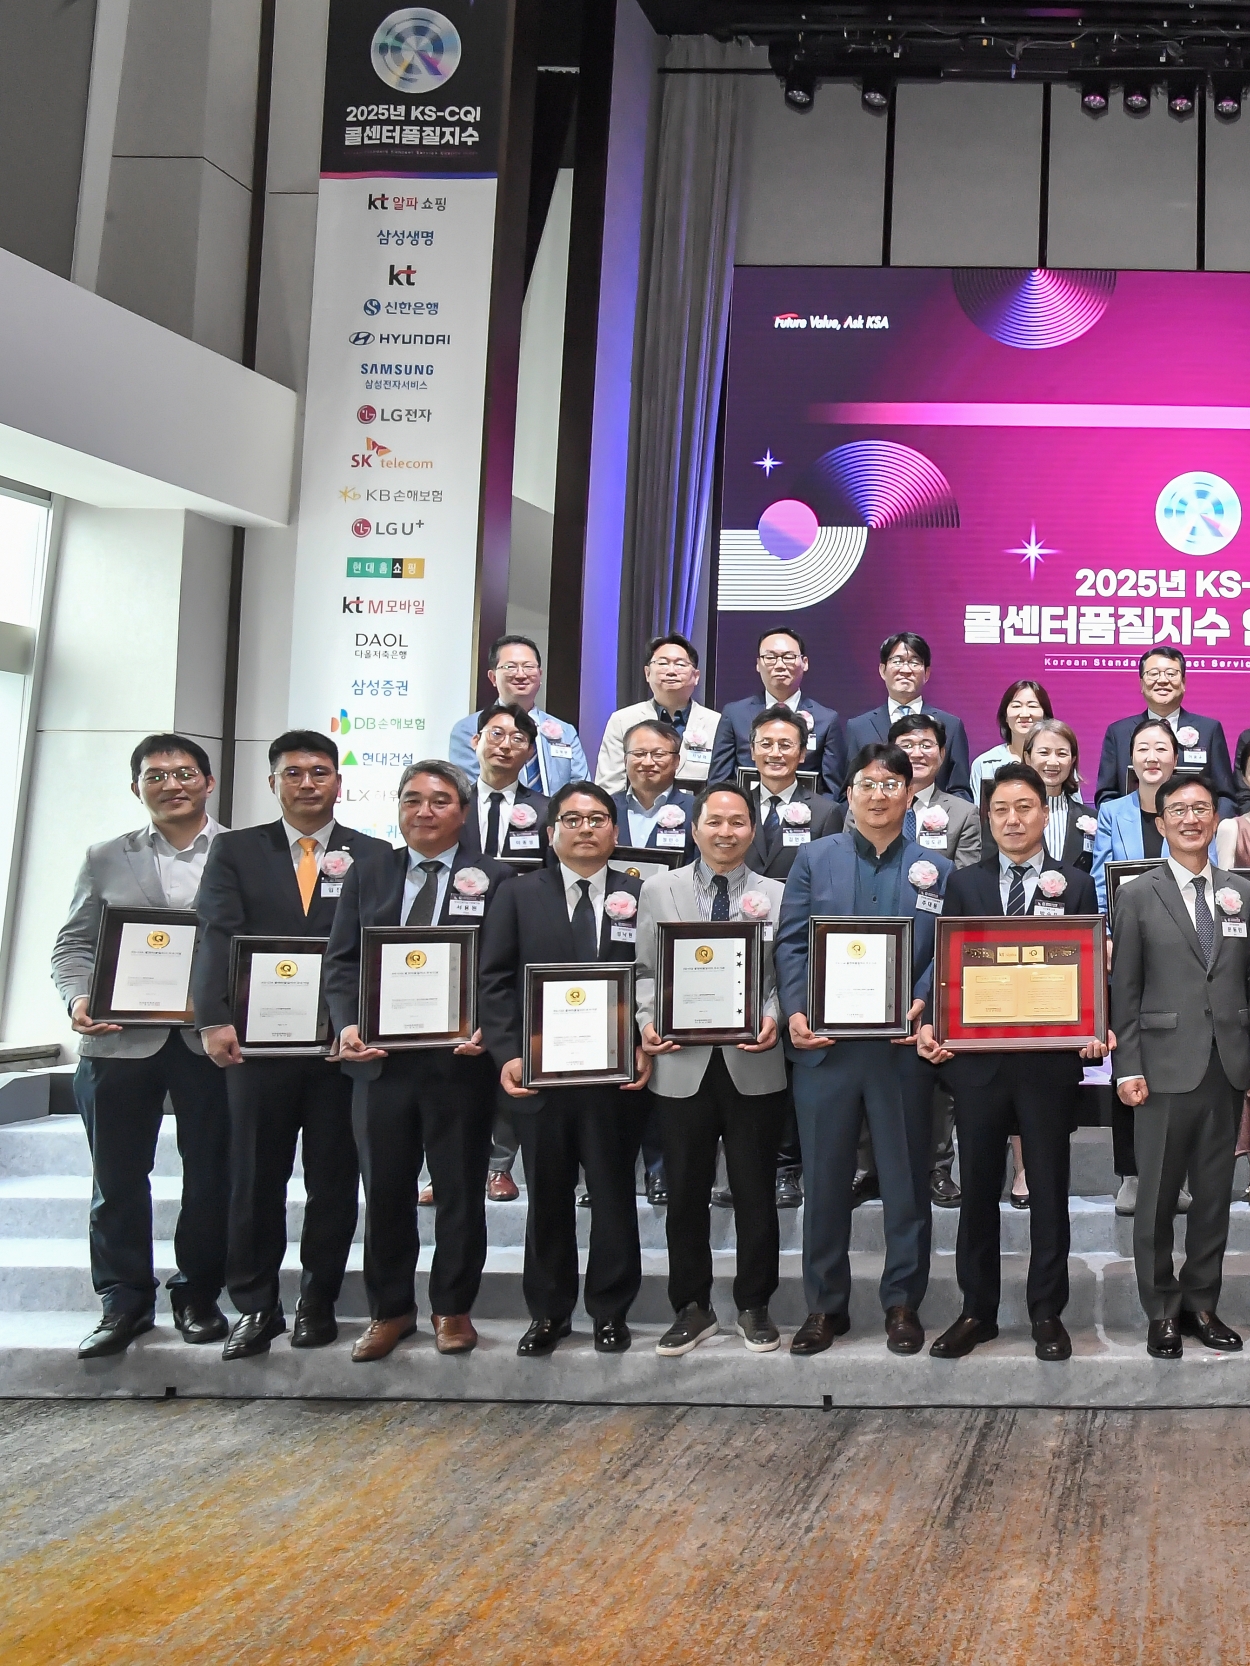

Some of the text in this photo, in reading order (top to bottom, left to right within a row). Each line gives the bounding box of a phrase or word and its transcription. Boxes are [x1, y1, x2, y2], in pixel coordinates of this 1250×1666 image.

[345, 104, 481, 123] 2025년 KS-CQI
[344, 125, 480, 146] 콜센터품질지수
[367, 193, 447, 212] kt 알파 쇼핑
[376, 229, 434, 246] 삼성생명
[388, 264, 417, 286] kt
[384, 301, 439, 316] 신한은행
[843, 314, 864, 329] Ask
[866, 315, 889, 329] KSA
[379, 333, 451, 345] HYUNDAI
[360, 363, 435, 376] SAMSUNG
[365, 379, 428, 390] 삼성전자서비스
[350, 453, 434, 469] SK telecom
[352, 561, 417, 575] 현대홈쇼핑
[1075, 567, 1187, 598] 2025년
[342, 596, 364, 614] kt
[963, 604, 1231, 646] 콜센터품질지수
[355, 633, 409, 648] DAOL
[354, 649, 408, 660] 다올저축은행
[1044, 657, 1088, 667] Korean
[1093, 658, 1140, 668] Standa
[351, 679, 409, 697] 삼성증권
[361, 751, 414, 767] 현대건설
[346, 789, 371, 802] LX
